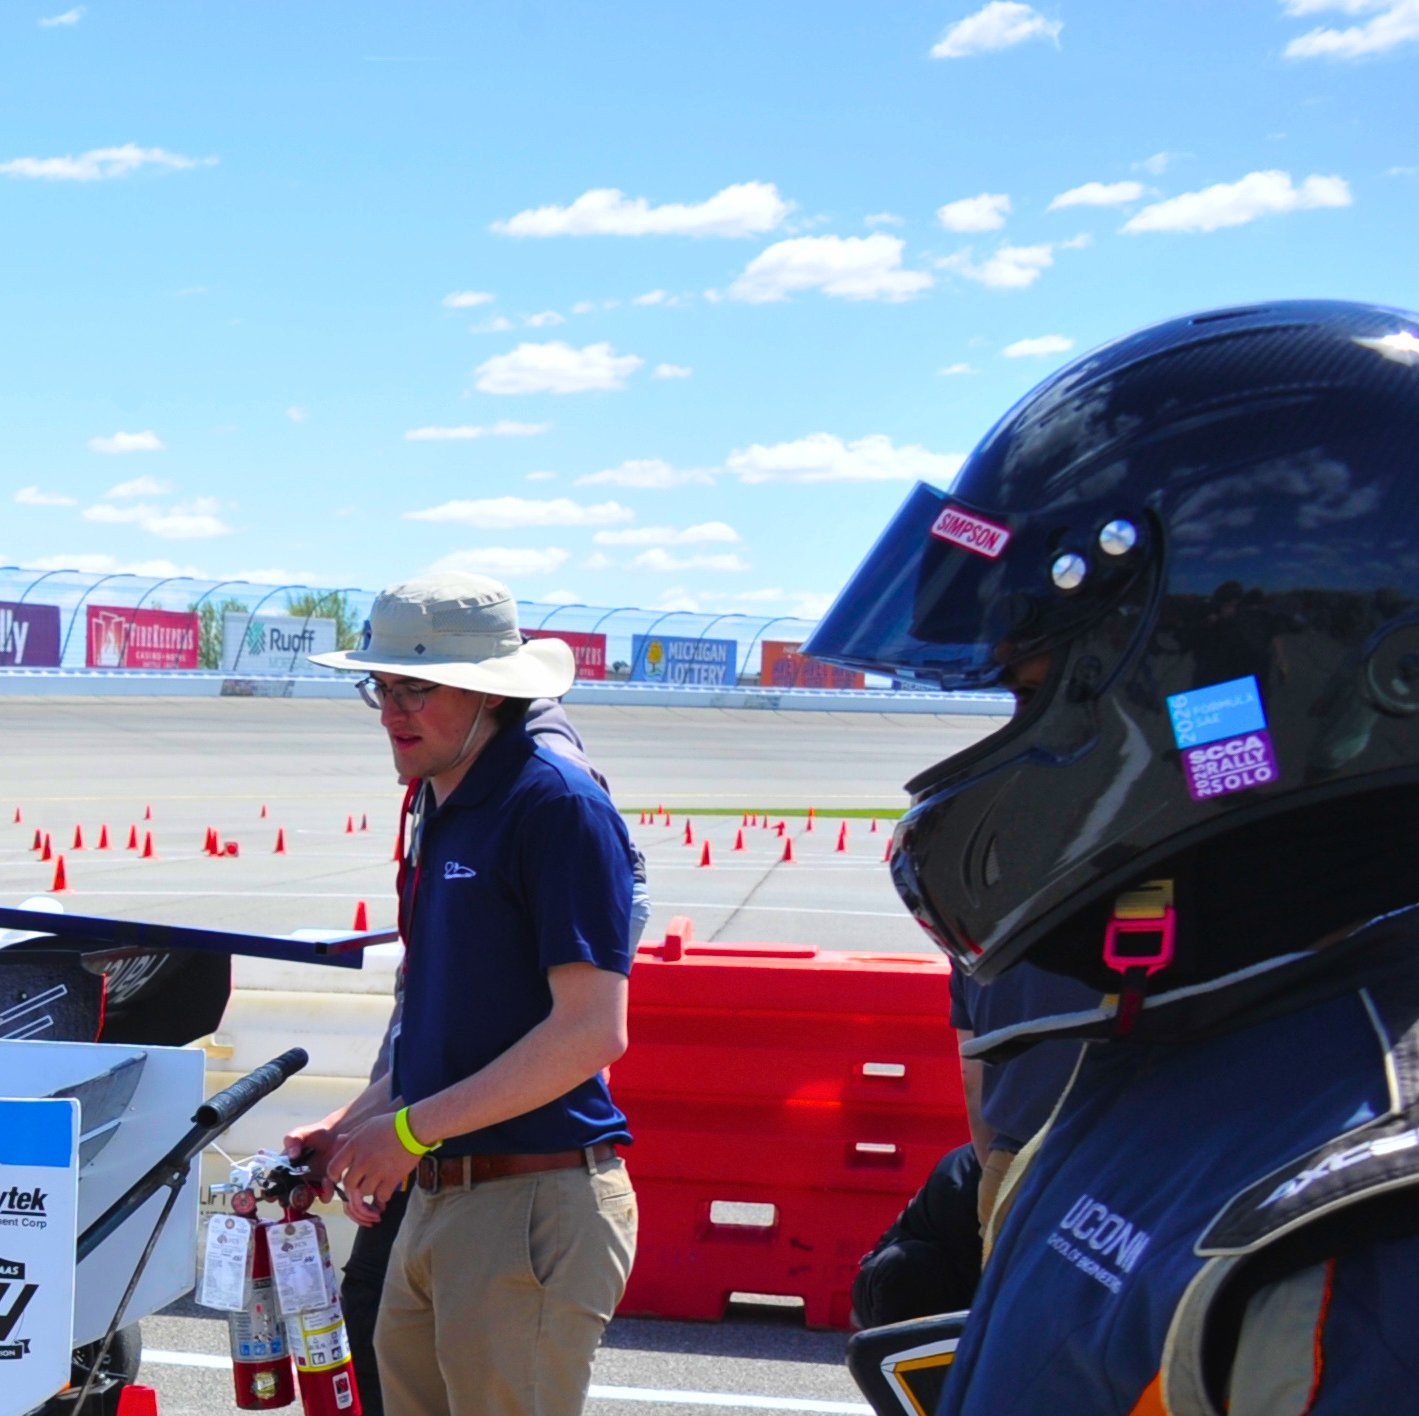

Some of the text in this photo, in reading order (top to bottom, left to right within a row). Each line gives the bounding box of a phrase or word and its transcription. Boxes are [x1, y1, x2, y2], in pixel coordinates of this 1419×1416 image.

[936, 512, 1001, 553] SIMPSON
[270, 628, 315, 652] Ruoff
[667, 641, 727, 661] MICHIGAN
[667, 665, 726, 685] LOTTERY
[1189, 736, 1264, 764] SCCA
[1206, 748, 1266, 775] RALLY
[1211, 767, 1272, 793] SOLO
[21, 1217, 47, 1229] Corp
